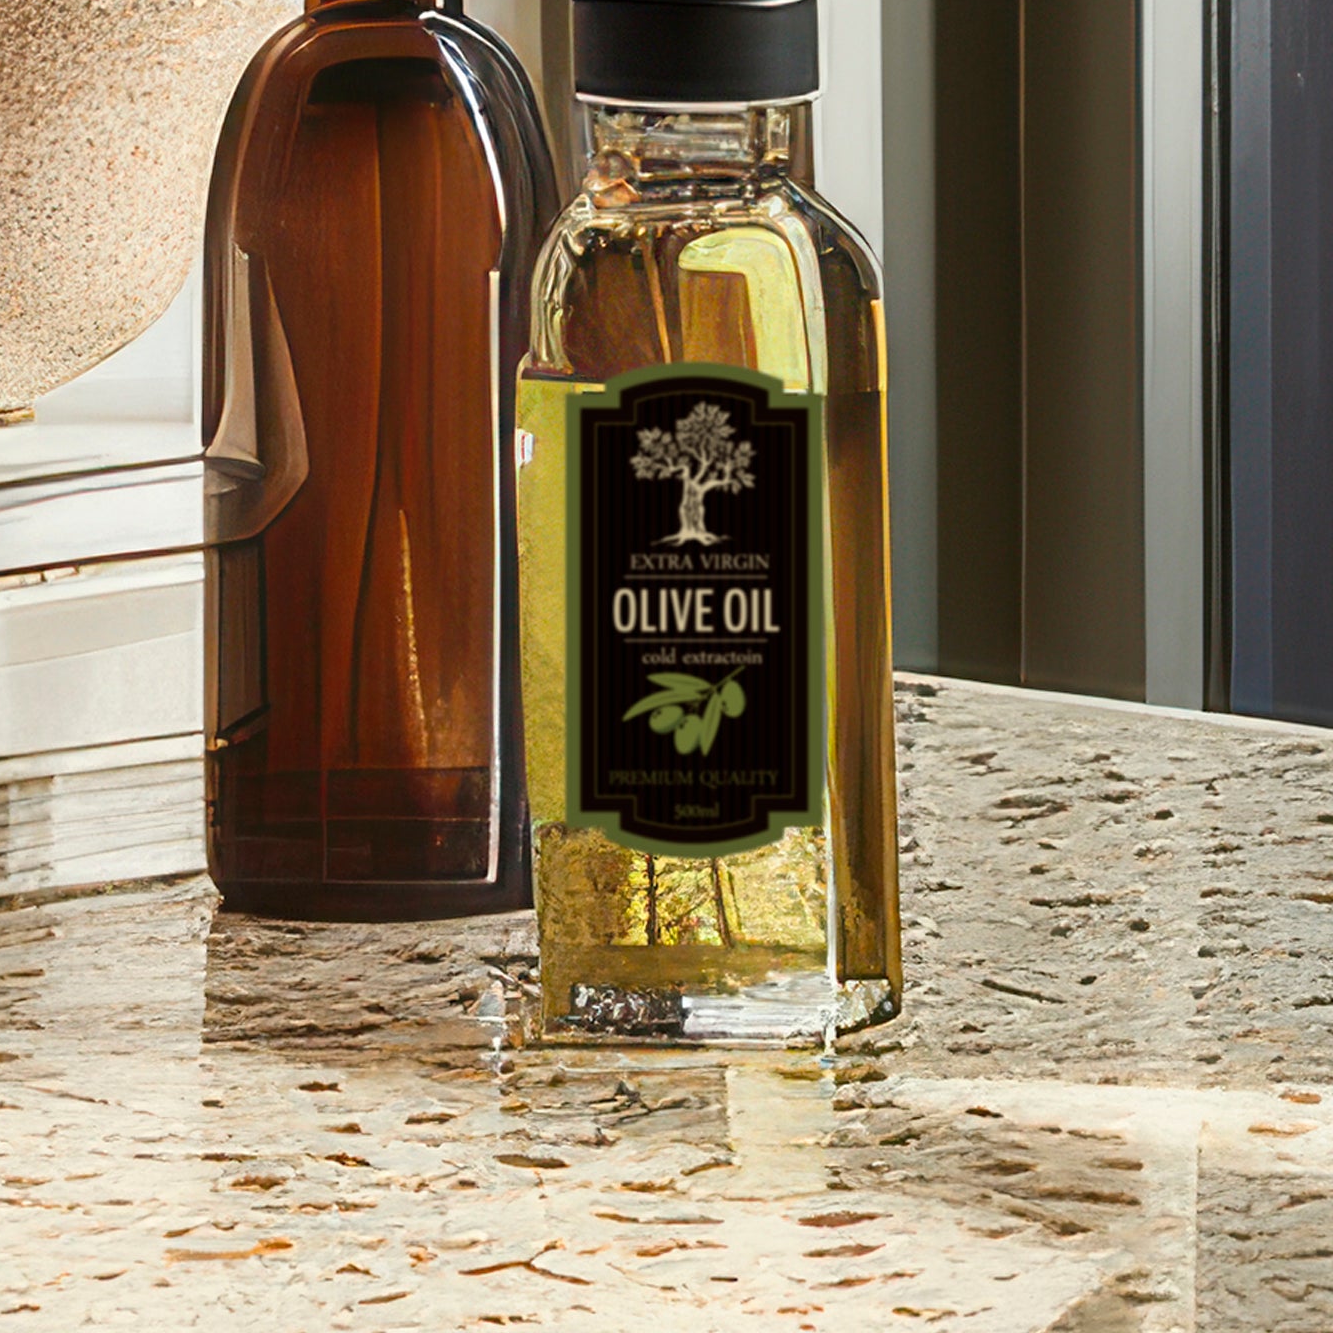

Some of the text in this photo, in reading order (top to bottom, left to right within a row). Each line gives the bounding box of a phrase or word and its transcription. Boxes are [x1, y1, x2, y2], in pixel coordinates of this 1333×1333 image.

[630, 554, 770, 570] EXTRA VIRGIN
[612, 587, 781, 634] OLIVE OIL
[641, 647, 676, 664] cold
[609, 769, 779, 789] PREMIUM QUALITY
